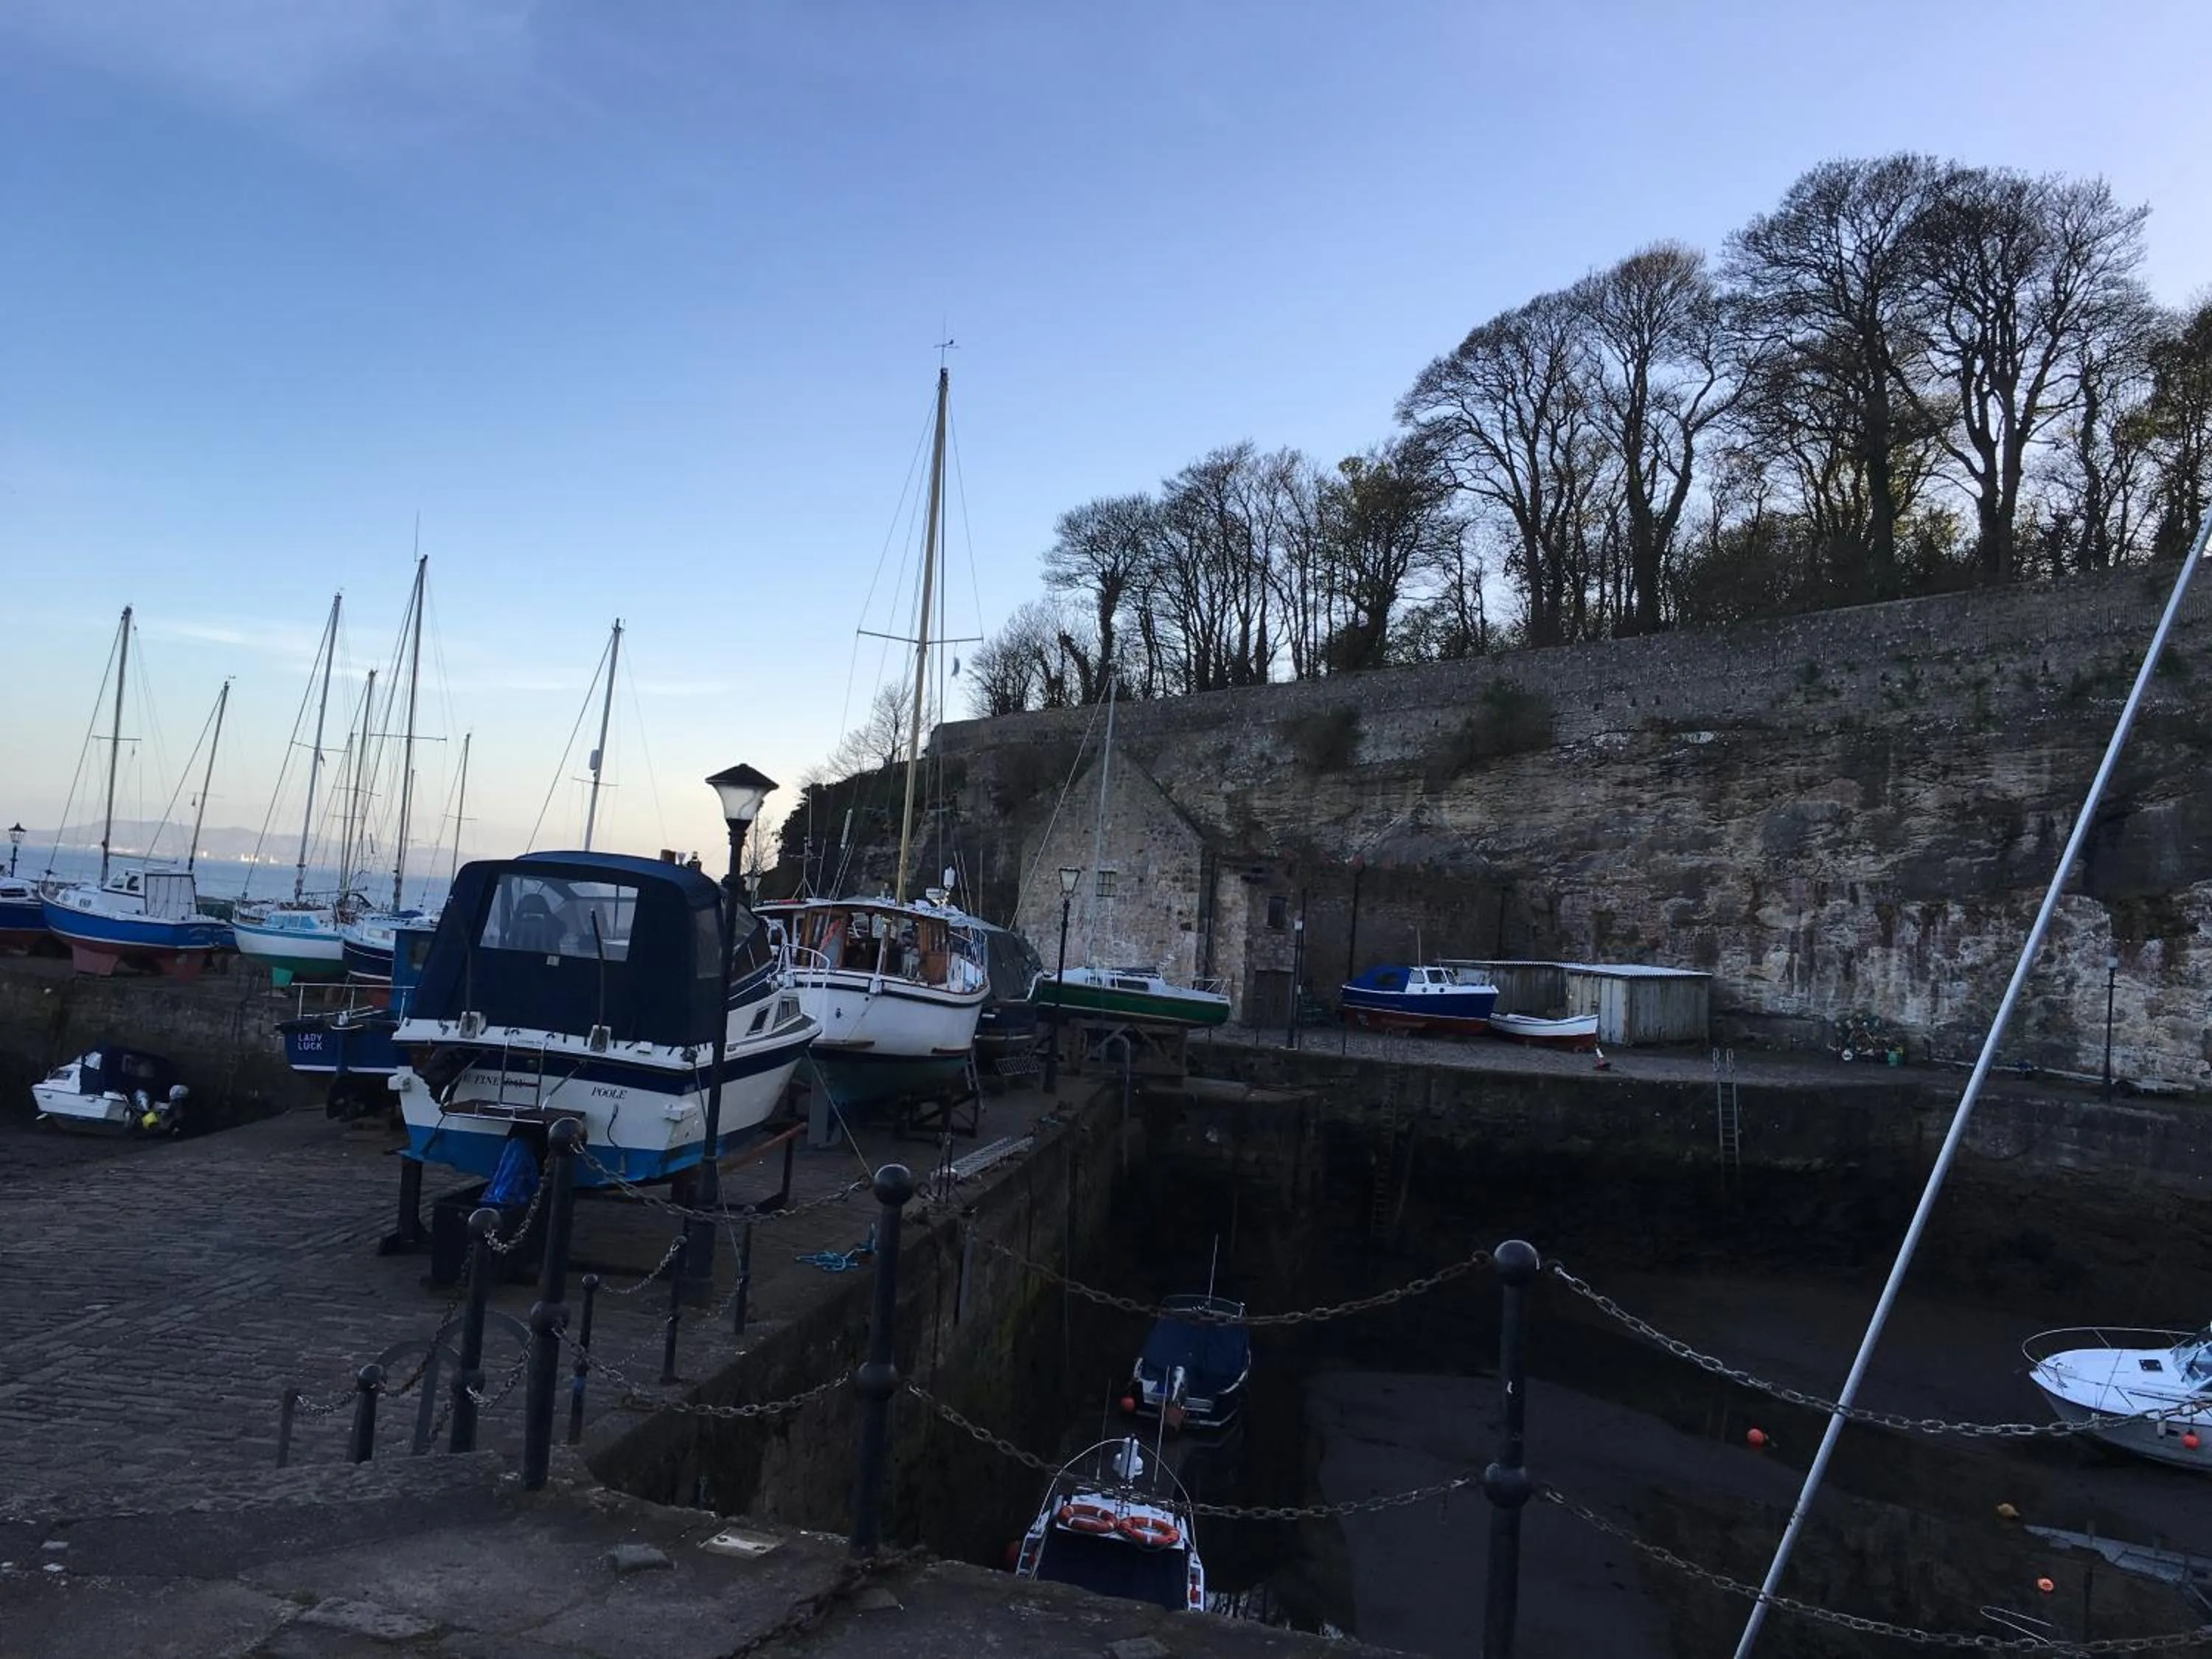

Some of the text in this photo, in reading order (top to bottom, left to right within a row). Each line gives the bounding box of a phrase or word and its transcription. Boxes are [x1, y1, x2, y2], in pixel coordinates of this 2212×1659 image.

[297, 1032, 322, 1041] LADY
[297, 1042, 322, 1051] LUCK
[591, 1085, 628, 1100] POOLE
